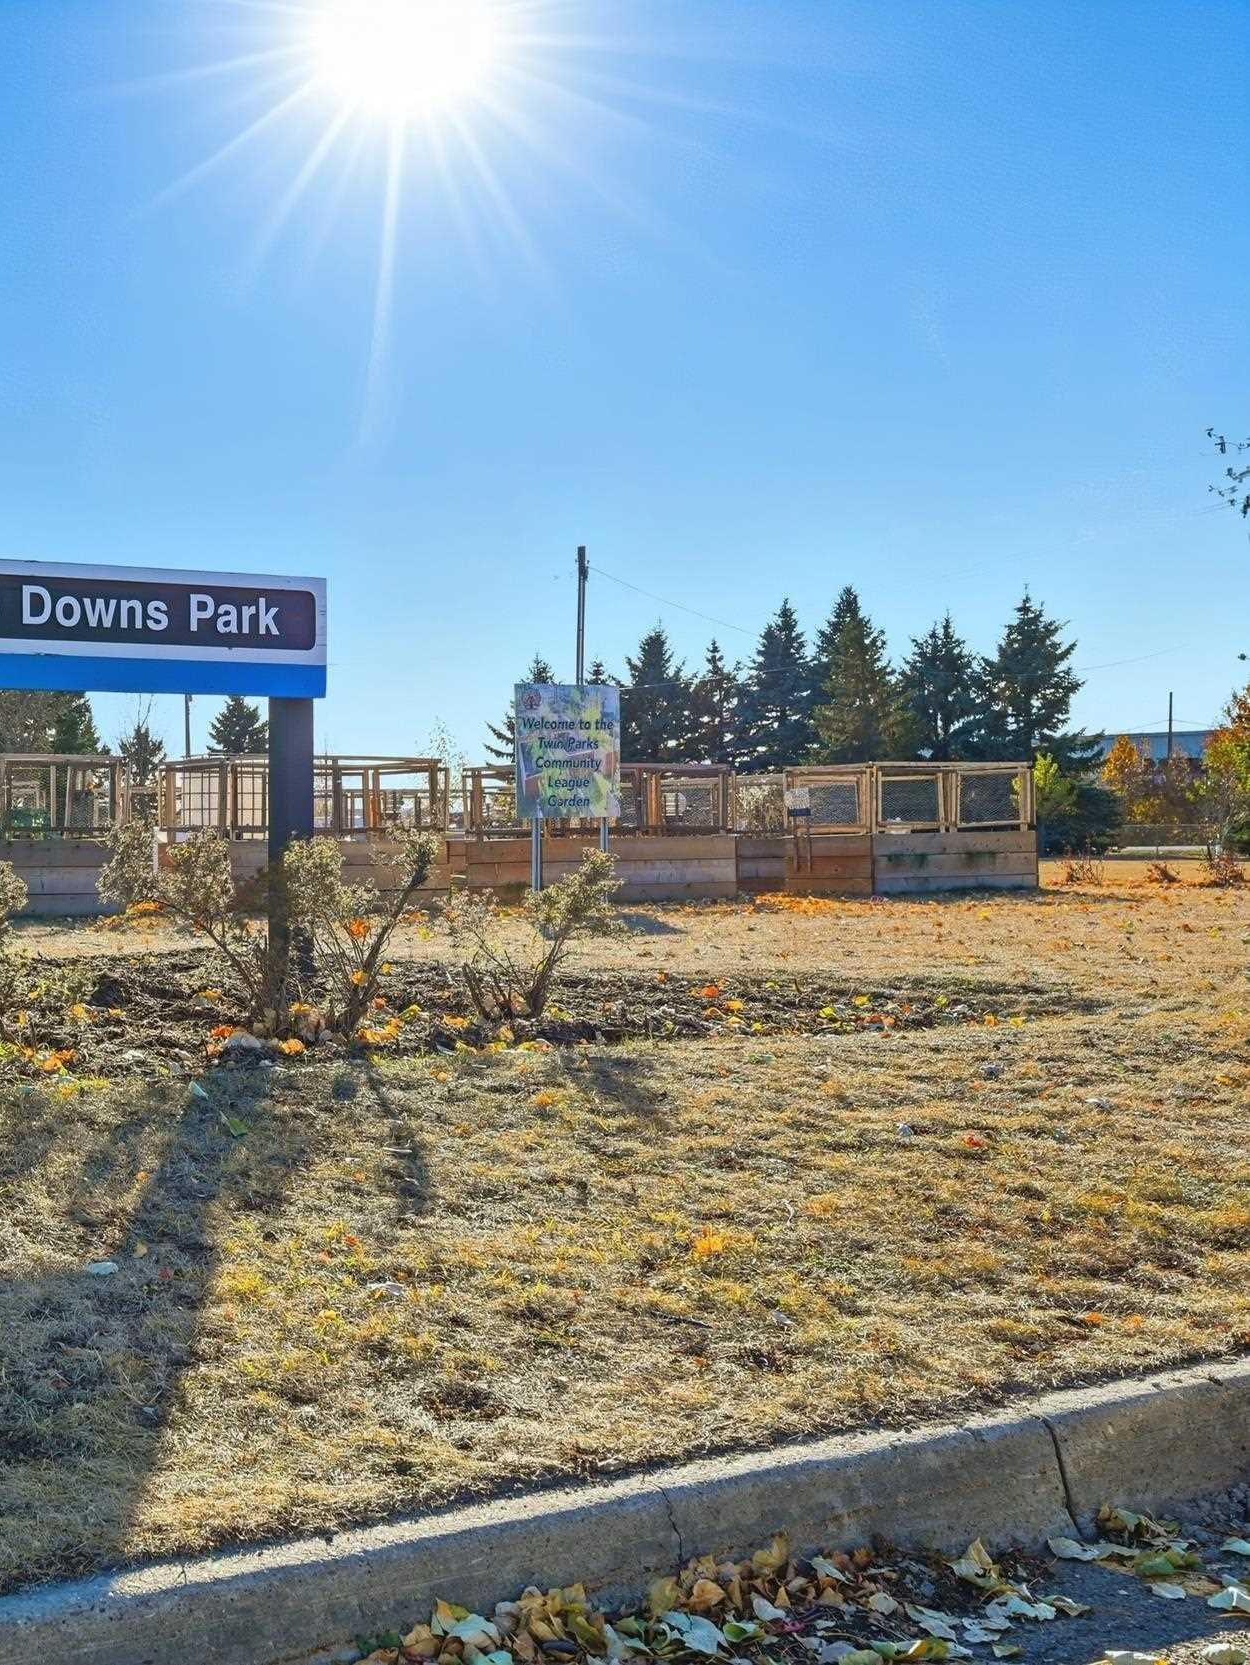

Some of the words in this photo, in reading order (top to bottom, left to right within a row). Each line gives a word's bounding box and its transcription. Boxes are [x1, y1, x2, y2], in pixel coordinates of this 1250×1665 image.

[22, 584, 169, 632] Downs
[189, 593, 281, 636] Park
[522, 718, 575, 730] Welcome
[579, 719, 592, 730] to
[595, 718, 614, 730] the
[538, 737, 566, 749] Twin
[567, 737, 599, 750] Parks
[535, 756, 602, 773] Community
[548, 775, 590, 791] League
[547, 794, 590, 807] Garden
